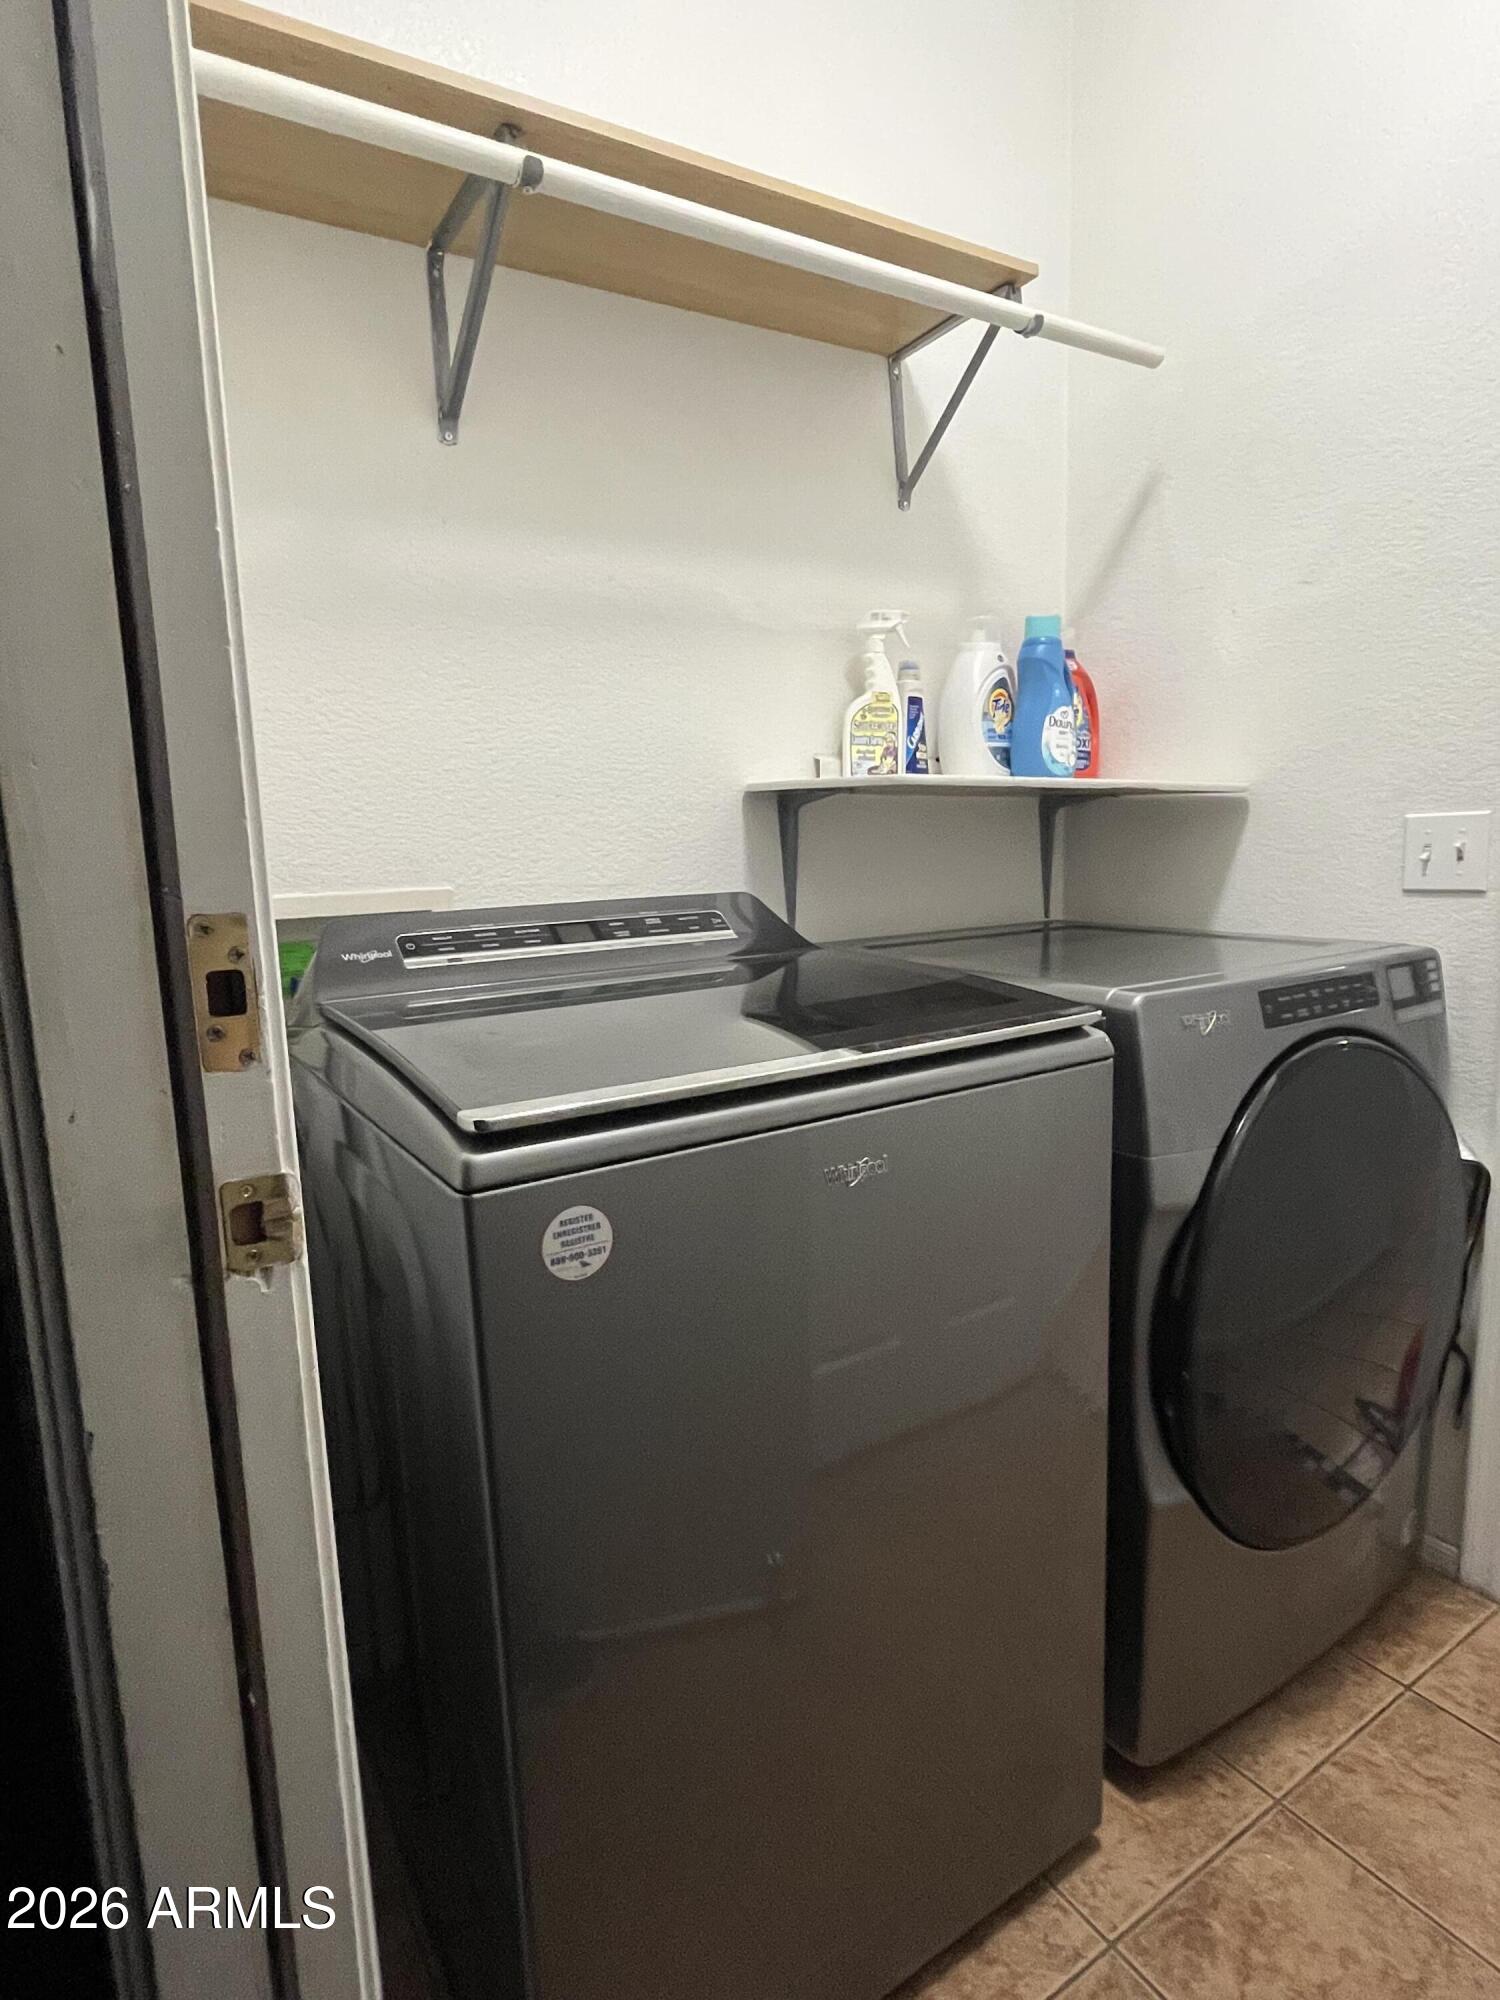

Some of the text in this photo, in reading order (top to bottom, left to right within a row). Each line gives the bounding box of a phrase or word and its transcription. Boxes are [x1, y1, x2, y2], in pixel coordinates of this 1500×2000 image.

[992, 698, 1010, 714] Tide
[341, 950, 392, 963] Whirlpool
[559, 1213, 594, 1227] REGISTER
